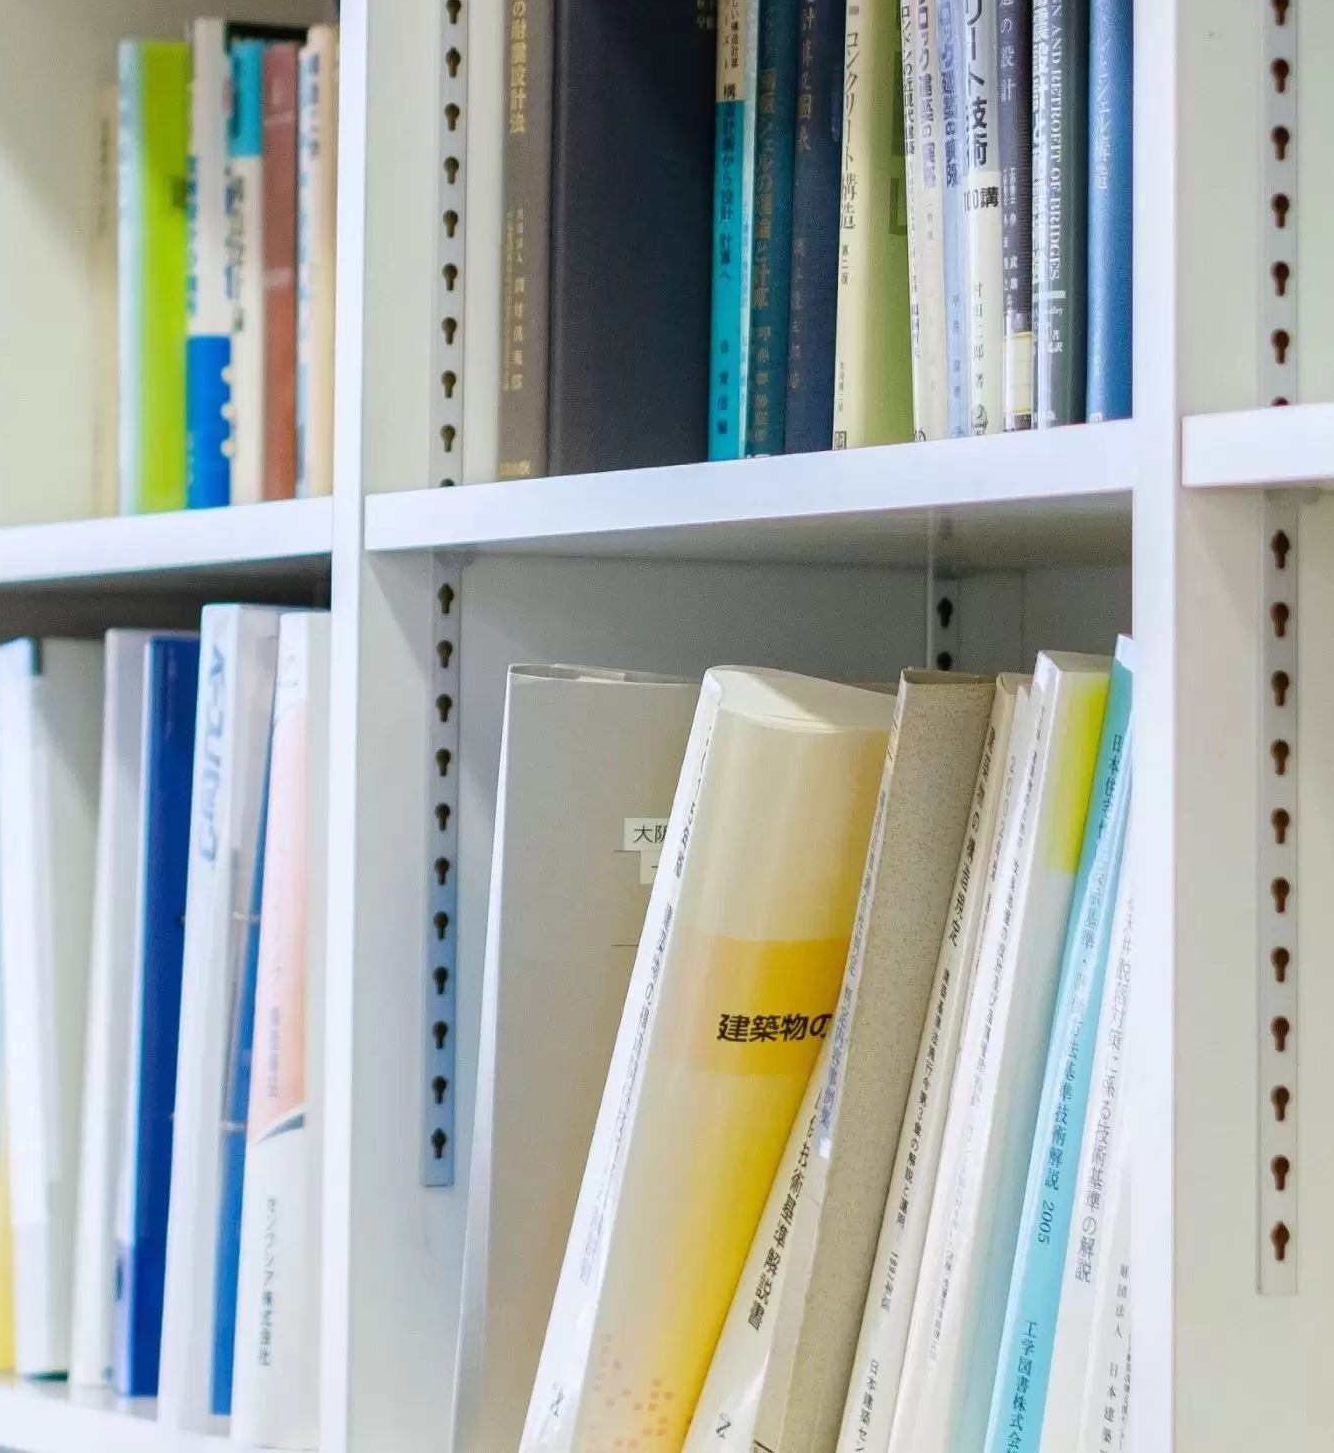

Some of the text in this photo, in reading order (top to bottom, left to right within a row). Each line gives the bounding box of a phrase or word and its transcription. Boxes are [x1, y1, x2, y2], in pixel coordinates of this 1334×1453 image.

[1051, 26, 1063, 66] AND
[840, 31, 860, 229] コンクリート構造
[1050, 70, 1063, 163] RETROFIT
[1050, 168, 1062, 194] OF
[1049, 203, 1062, 280] BRIDGES
[717, 1012, 832, 1044] 建築物の
[1036, 1199, 1056, 1247] 2005
[1005, 1319, 1038, 1453] 工学図書株式会
[1100, 1362, 1119, 1453] 日本建築
